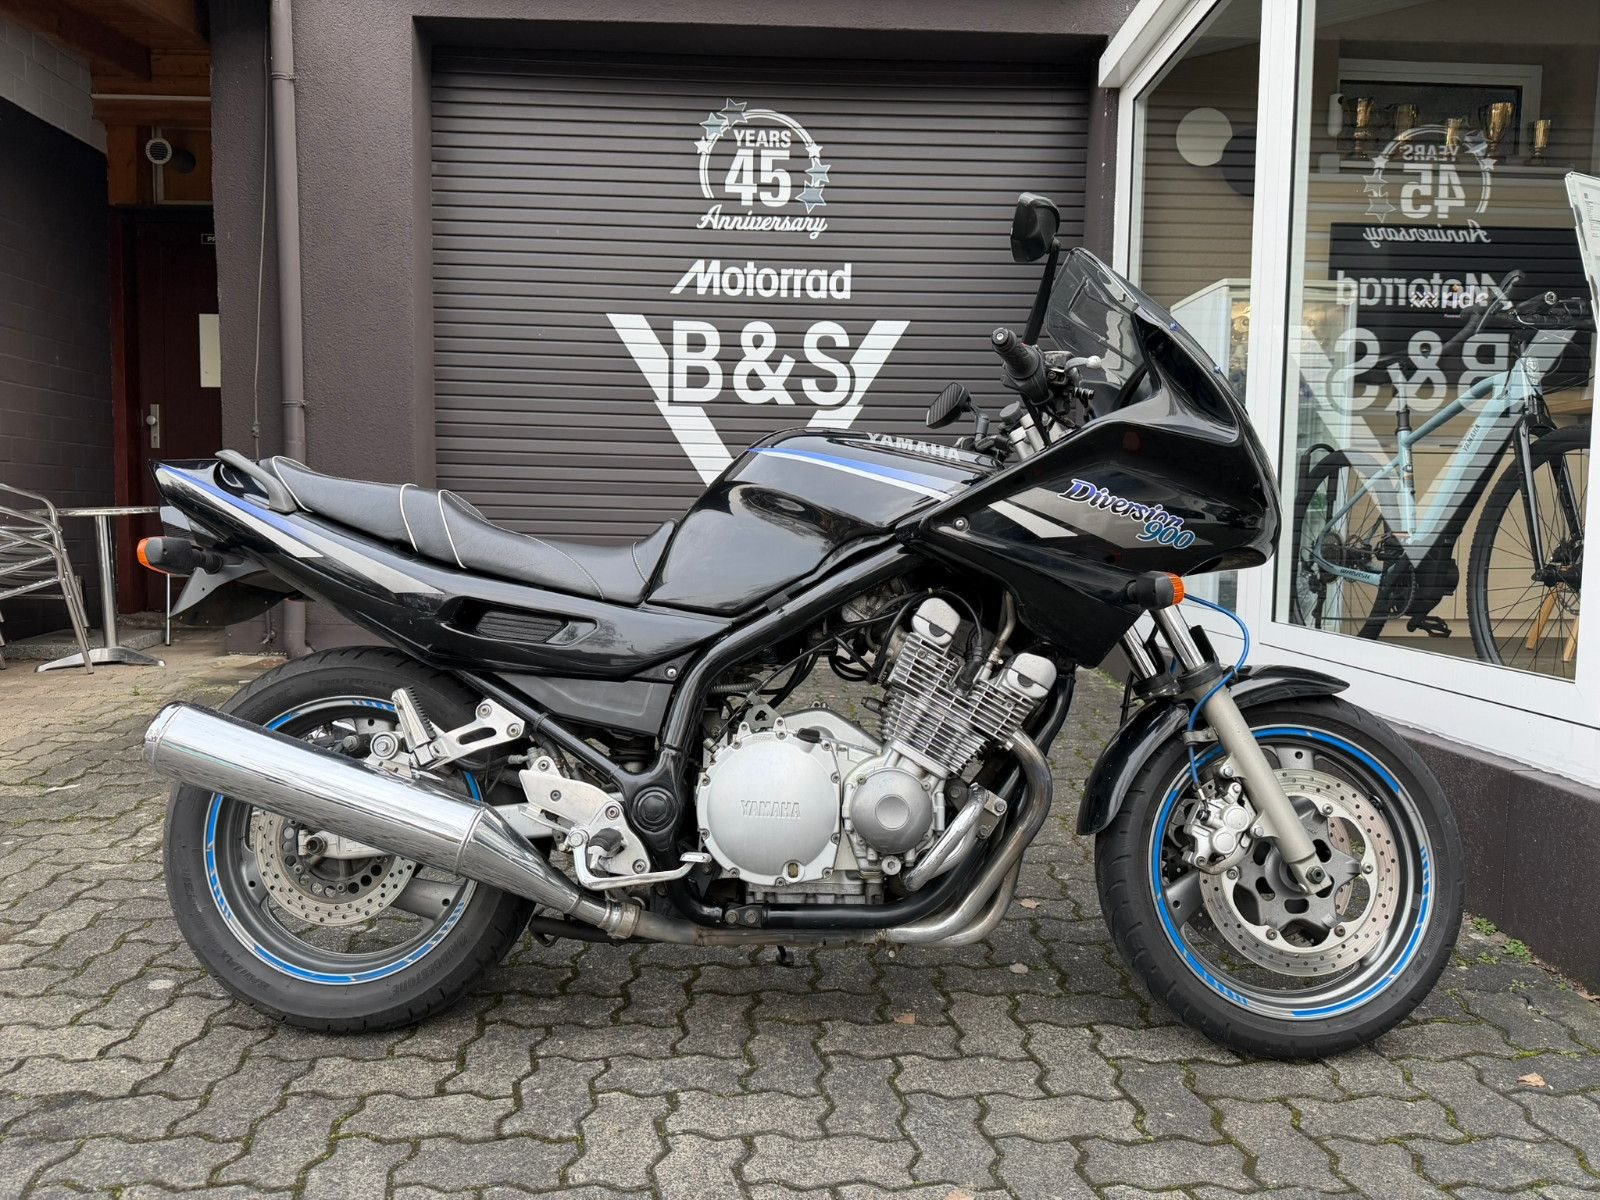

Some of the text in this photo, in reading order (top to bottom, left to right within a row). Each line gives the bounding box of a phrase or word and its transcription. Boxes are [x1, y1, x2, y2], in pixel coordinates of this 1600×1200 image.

[733, 129, 791, 148] YEARS
[724, 149, 792, 207] 45
[696, 204, 828, 240] Anniversary
[669, 259, 852, 300] Motorrad
[672, 320, 852, 406] B&S
[867, 432, 961, 462] YAMAHA
[1057, 478, 1186, 529] Diversion
[1136, 521, 1196, 550] 900
[740, 800, 801, 818] YAMAHA
